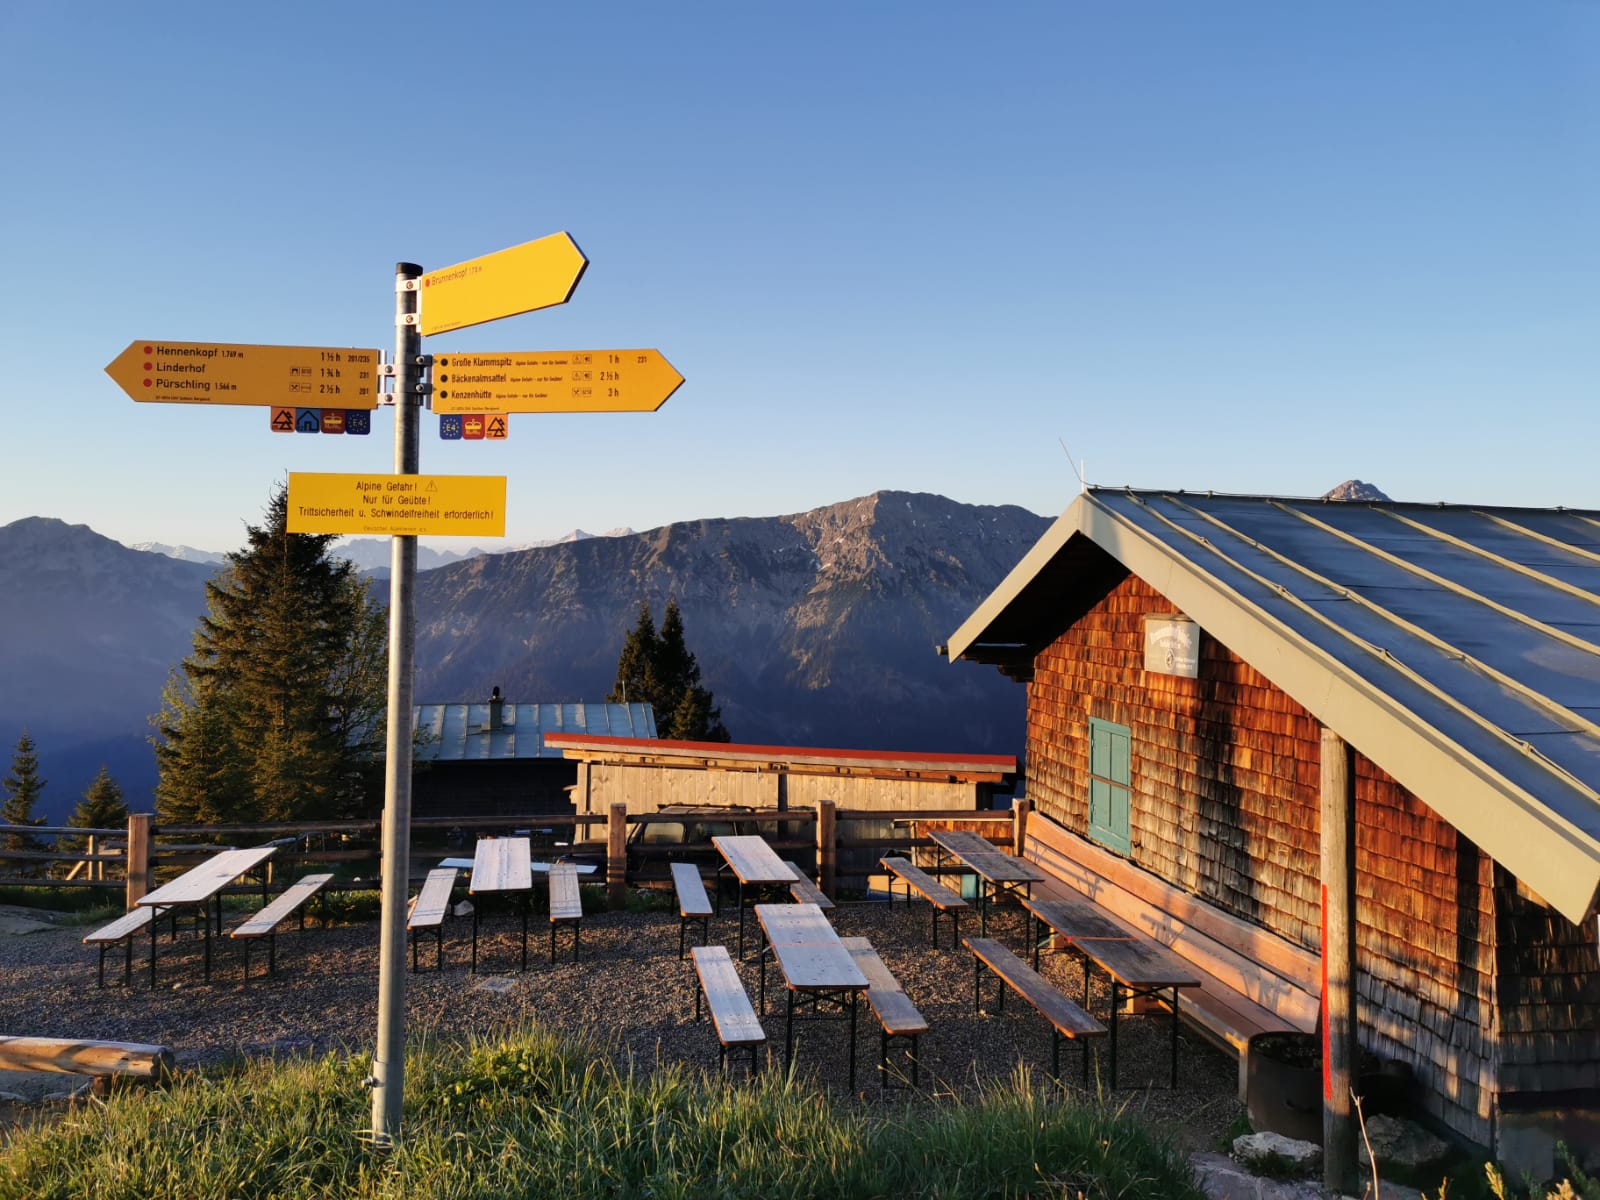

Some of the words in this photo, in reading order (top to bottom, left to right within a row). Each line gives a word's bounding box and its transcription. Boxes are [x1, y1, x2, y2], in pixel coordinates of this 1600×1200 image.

[156, 346, 219, 359] Hennenkopf
[335, 352, 341, 362] h
[451, 357, 472, 368] Große
[473, 357, 513, 369] Klammspitz
[609, 354, 613, 364] 1
[614, 354, 620, 364] h
[156, 362, 206, 373] Linderhof
[335, 368, 341, 378] h
[600, 371, 605, 381] 2
[614, 371, 620, 381] h
[156, 378, 211, 391] Pürschling
[335, 384, 341, 394] h
[607, 387, 613, 397] 3
[614, 387, 619, 397] h
[446, 423, 456, 432] E4
[356, 481, 382, 493] Alpine
[363, 495, 377, 505] Nur
[382, 494, 393, 505] für
[299, 506, 354, 517] Trittsicherheit
[358, 509, 367, 518] u.
[370, 507, 440, 519] Schwindelfreiheit
